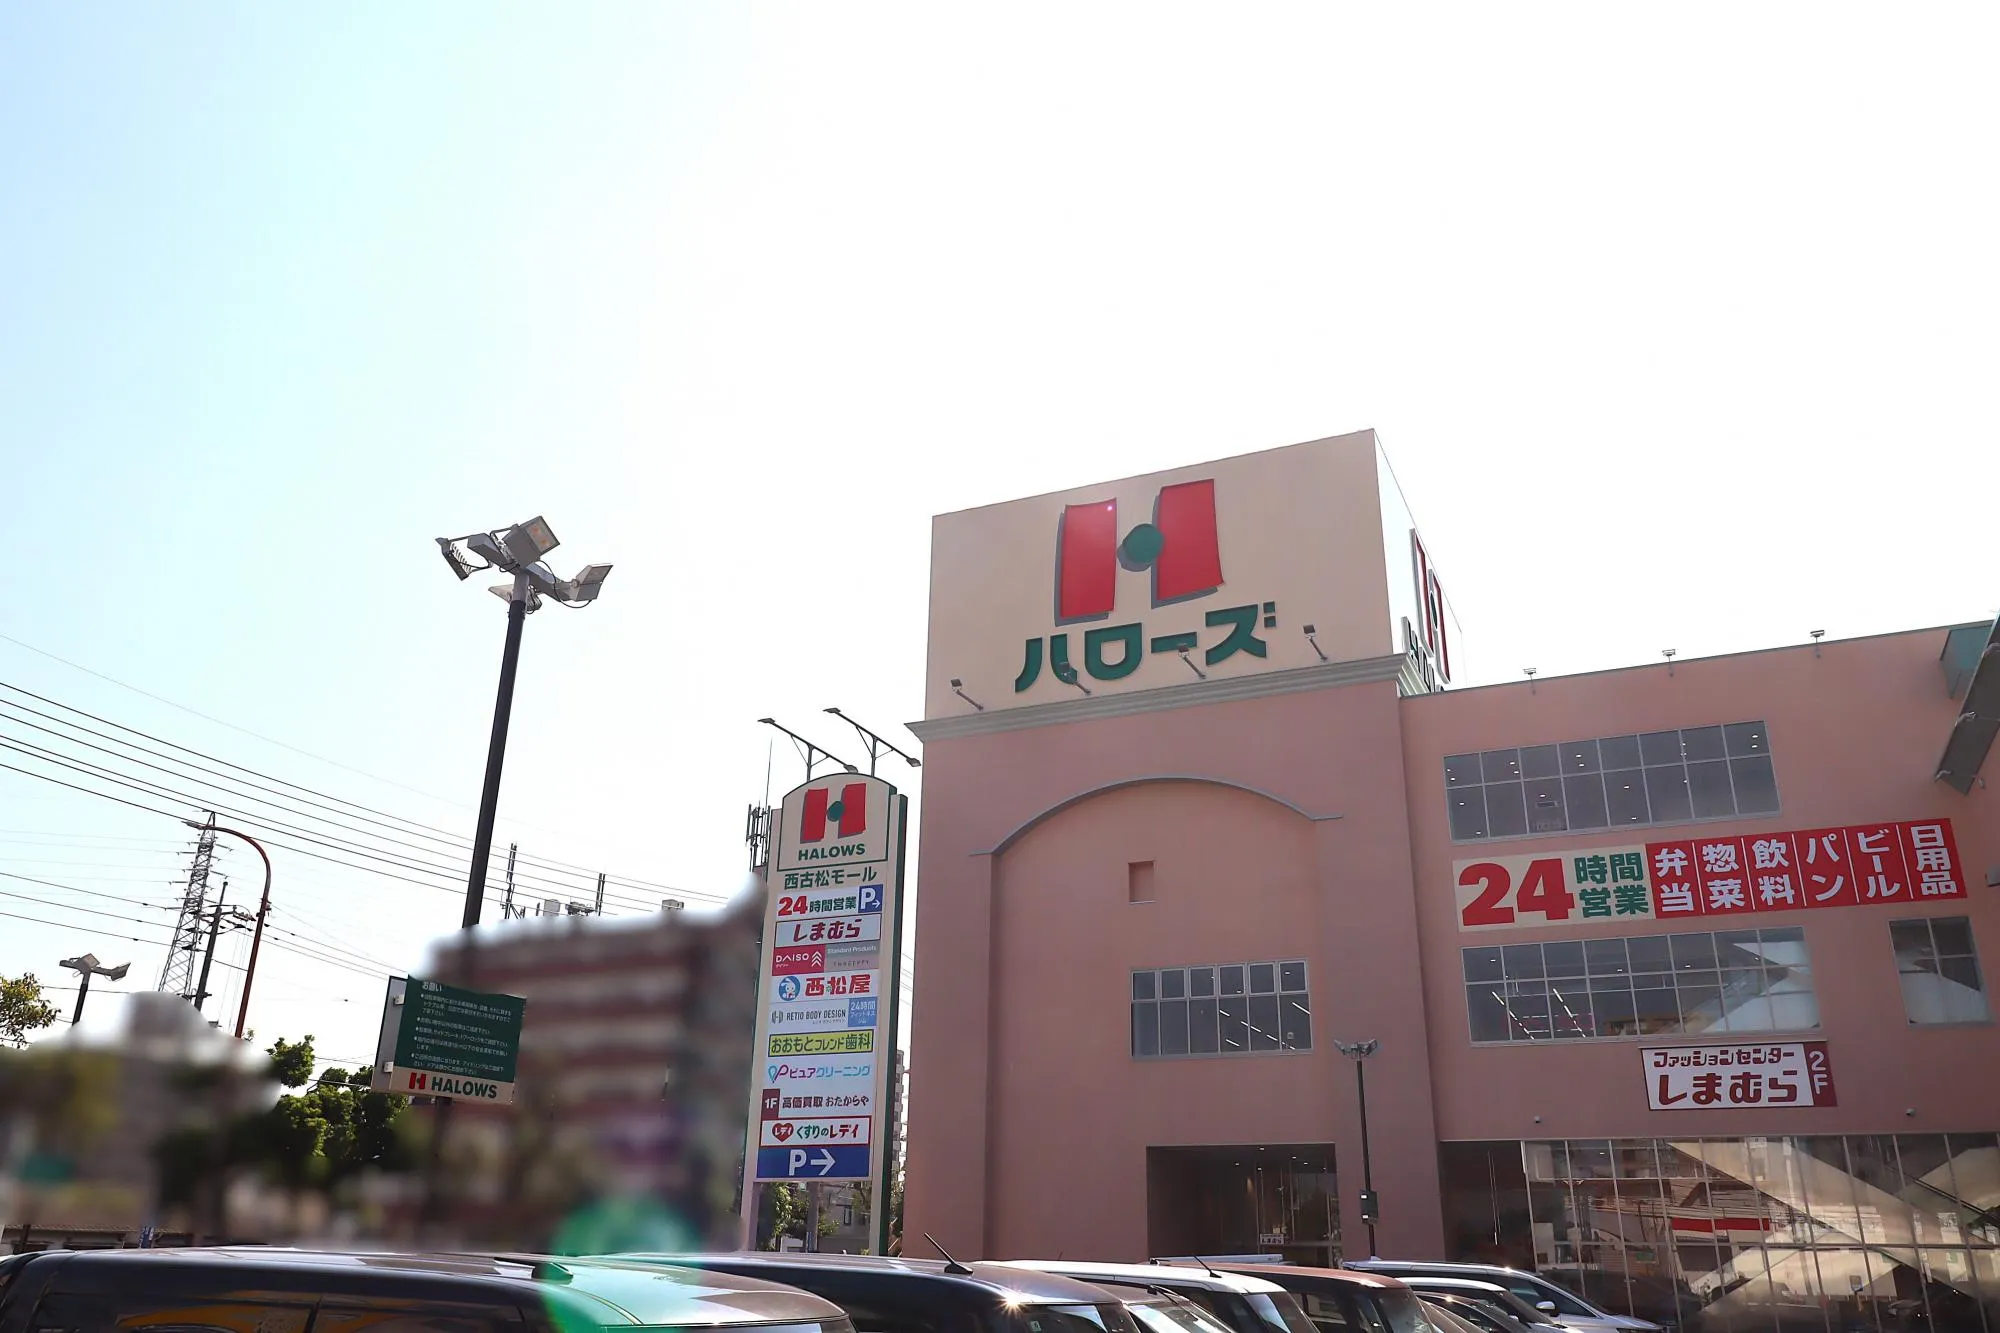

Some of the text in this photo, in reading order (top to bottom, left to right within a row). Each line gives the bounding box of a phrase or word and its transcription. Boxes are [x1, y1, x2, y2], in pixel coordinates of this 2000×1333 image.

[1015, 601, 1277, 693] ハローズ
[798, 843, 866, 861] HALOWS
[1857, 830, 1900, 898] ビール
[1911, 824, 1959, 895] 日用品
[784, 866, 877, 890] 西古松モール
[1575, 851, 1644, 884] 時間
[1654, 848, 1696, 913] 弁当
[1702, 843, 1746, 910] 惣菜
[1751, 840, 1796, 907] 飲料
[1806, 834, 1846, 902] パン
[1458, 858, 1575, 927] 24
[1578, 884, 1649, 918] 営業
[793, 919, 862, 943] しまむら
[775, 953, 810, 963] DAISO
[805, 974, 871, 997] 西松屋
[823, 1009, 847, 1019] DESIGN
[1653, 1047, 1795, 1068] ファッションセンター
[1809, 1050, 1829, 1095] 2F
[431, 1076, 498, 1099] HALOWS
[782, 1094, 869, 1108] 高価買取 おたからや
[1658, 1070, 1798, 1106] しまむら
[764, 1097, 777, 1109] 1F
[796, 1123, 859, 1139] くすりのレディ
[788, 1149, 807, 1177] P
